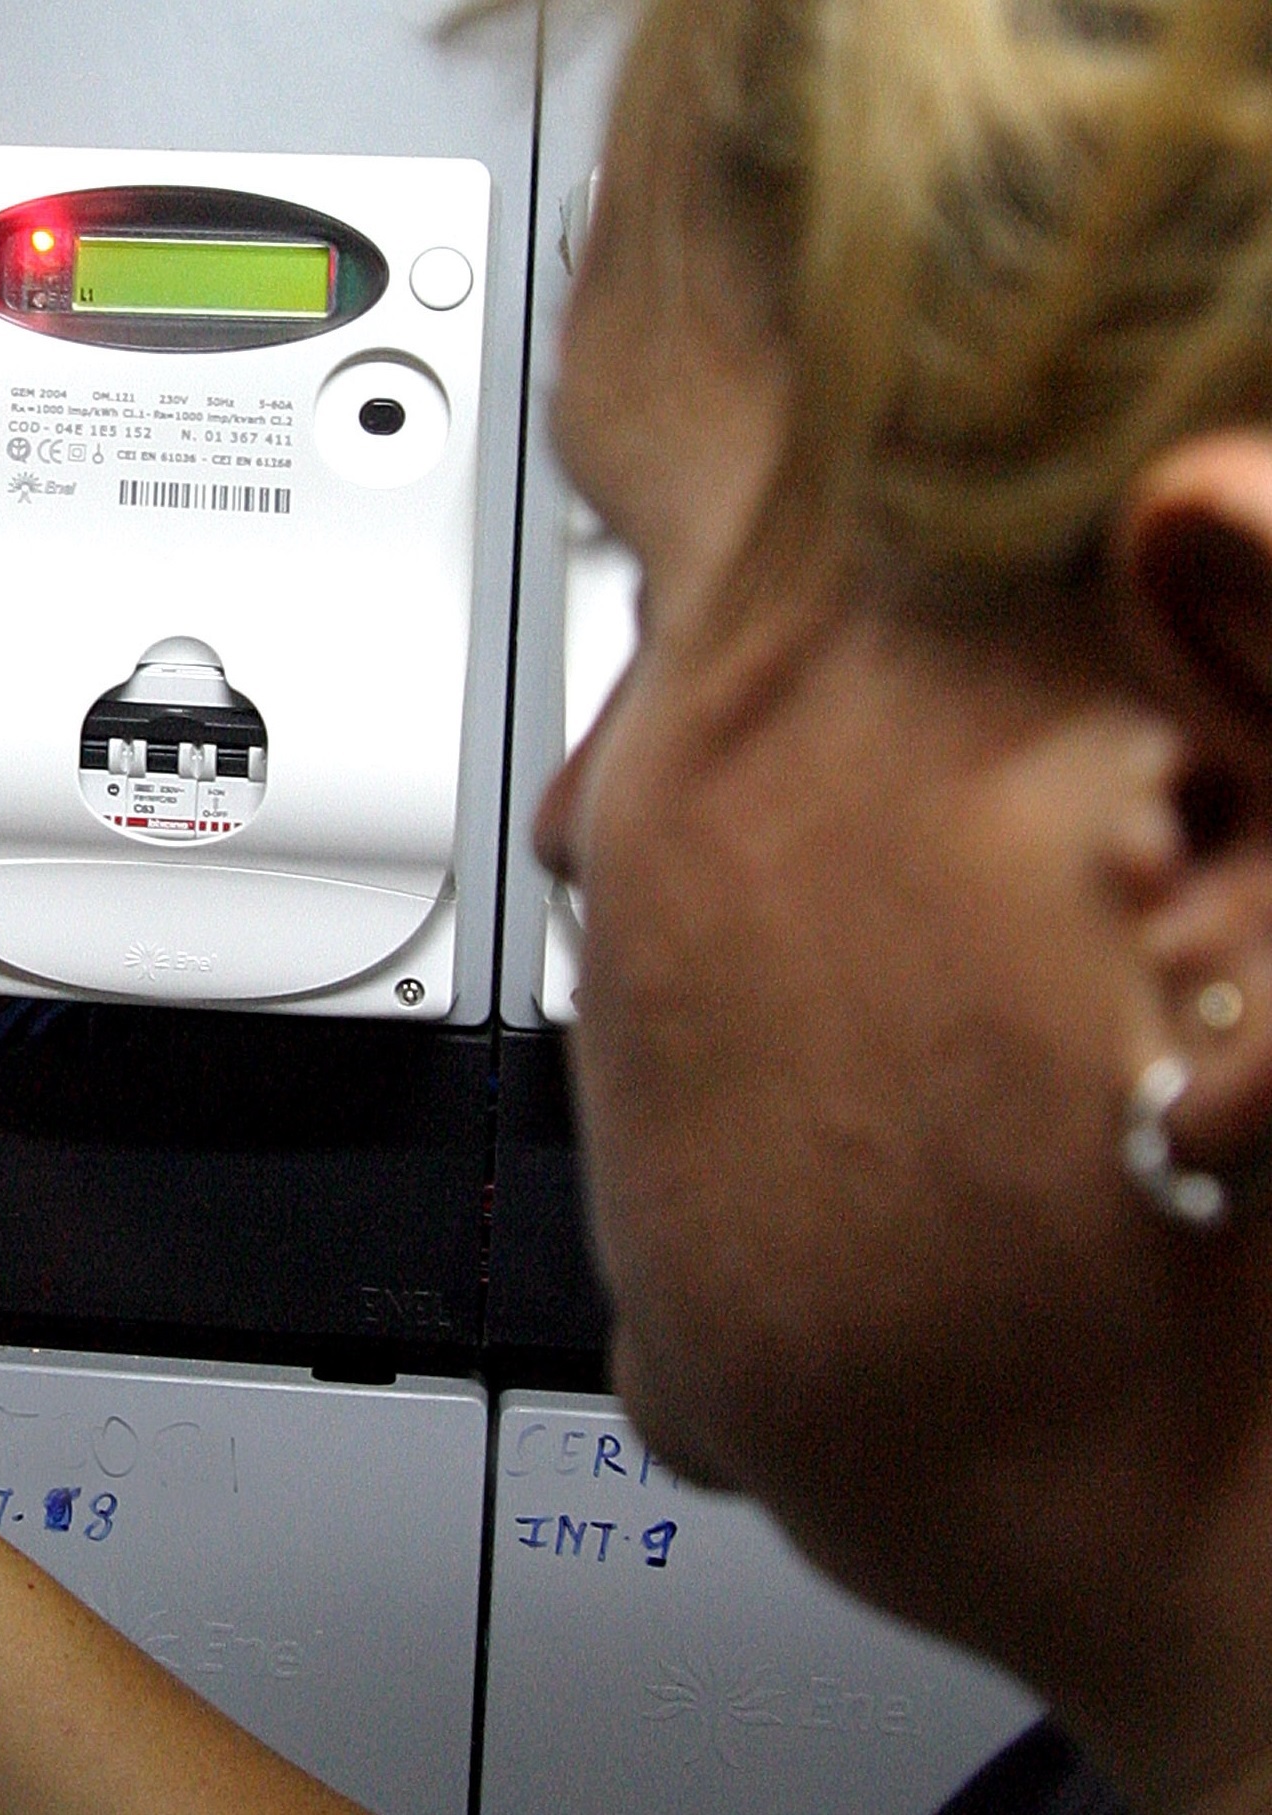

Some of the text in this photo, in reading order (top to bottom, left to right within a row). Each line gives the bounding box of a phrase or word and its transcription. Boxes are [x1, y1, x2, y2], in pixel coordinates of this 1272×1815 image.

[39, 389, 68, 399] 2004
[159, 394, 189, 405] 230V
[8, 421, 41, 433] COD
[55, 423, 84, 435] 04E
[125, 427, 152, 439] 152
[181, 430, 198, 442] N.
[205, 431, 223, 443] 01
[230, 433, 258, 445] 367
[264, 434, 293, 447] 411
